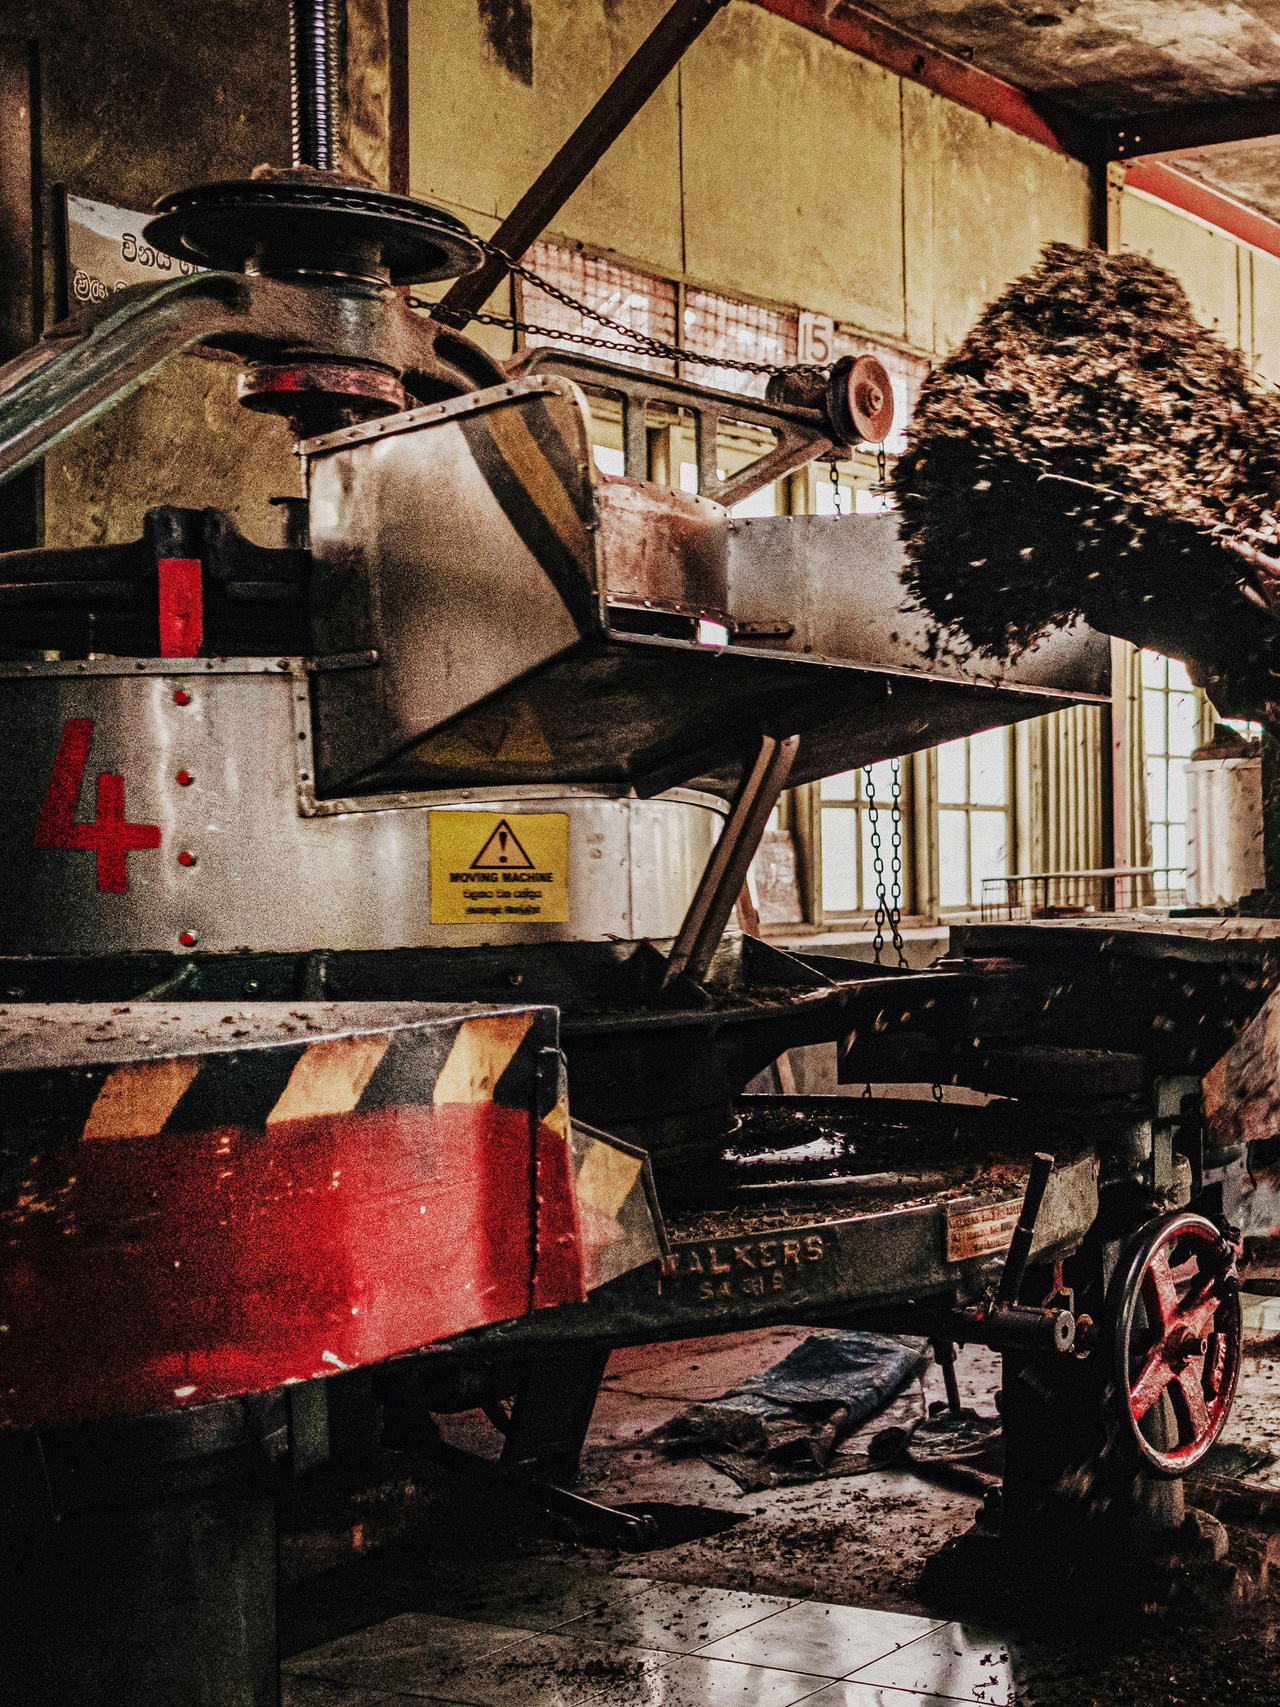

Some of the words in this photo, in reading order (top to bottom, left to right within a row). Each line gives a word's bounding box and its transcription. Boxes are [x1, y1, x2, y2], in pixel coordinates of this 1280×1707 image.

[802, 322, 830, 362] 15
[33, 719, 162, 893] 4
[450, 872, 498, 883] MOVING
[502, 872, 554, 883] MACHINE
